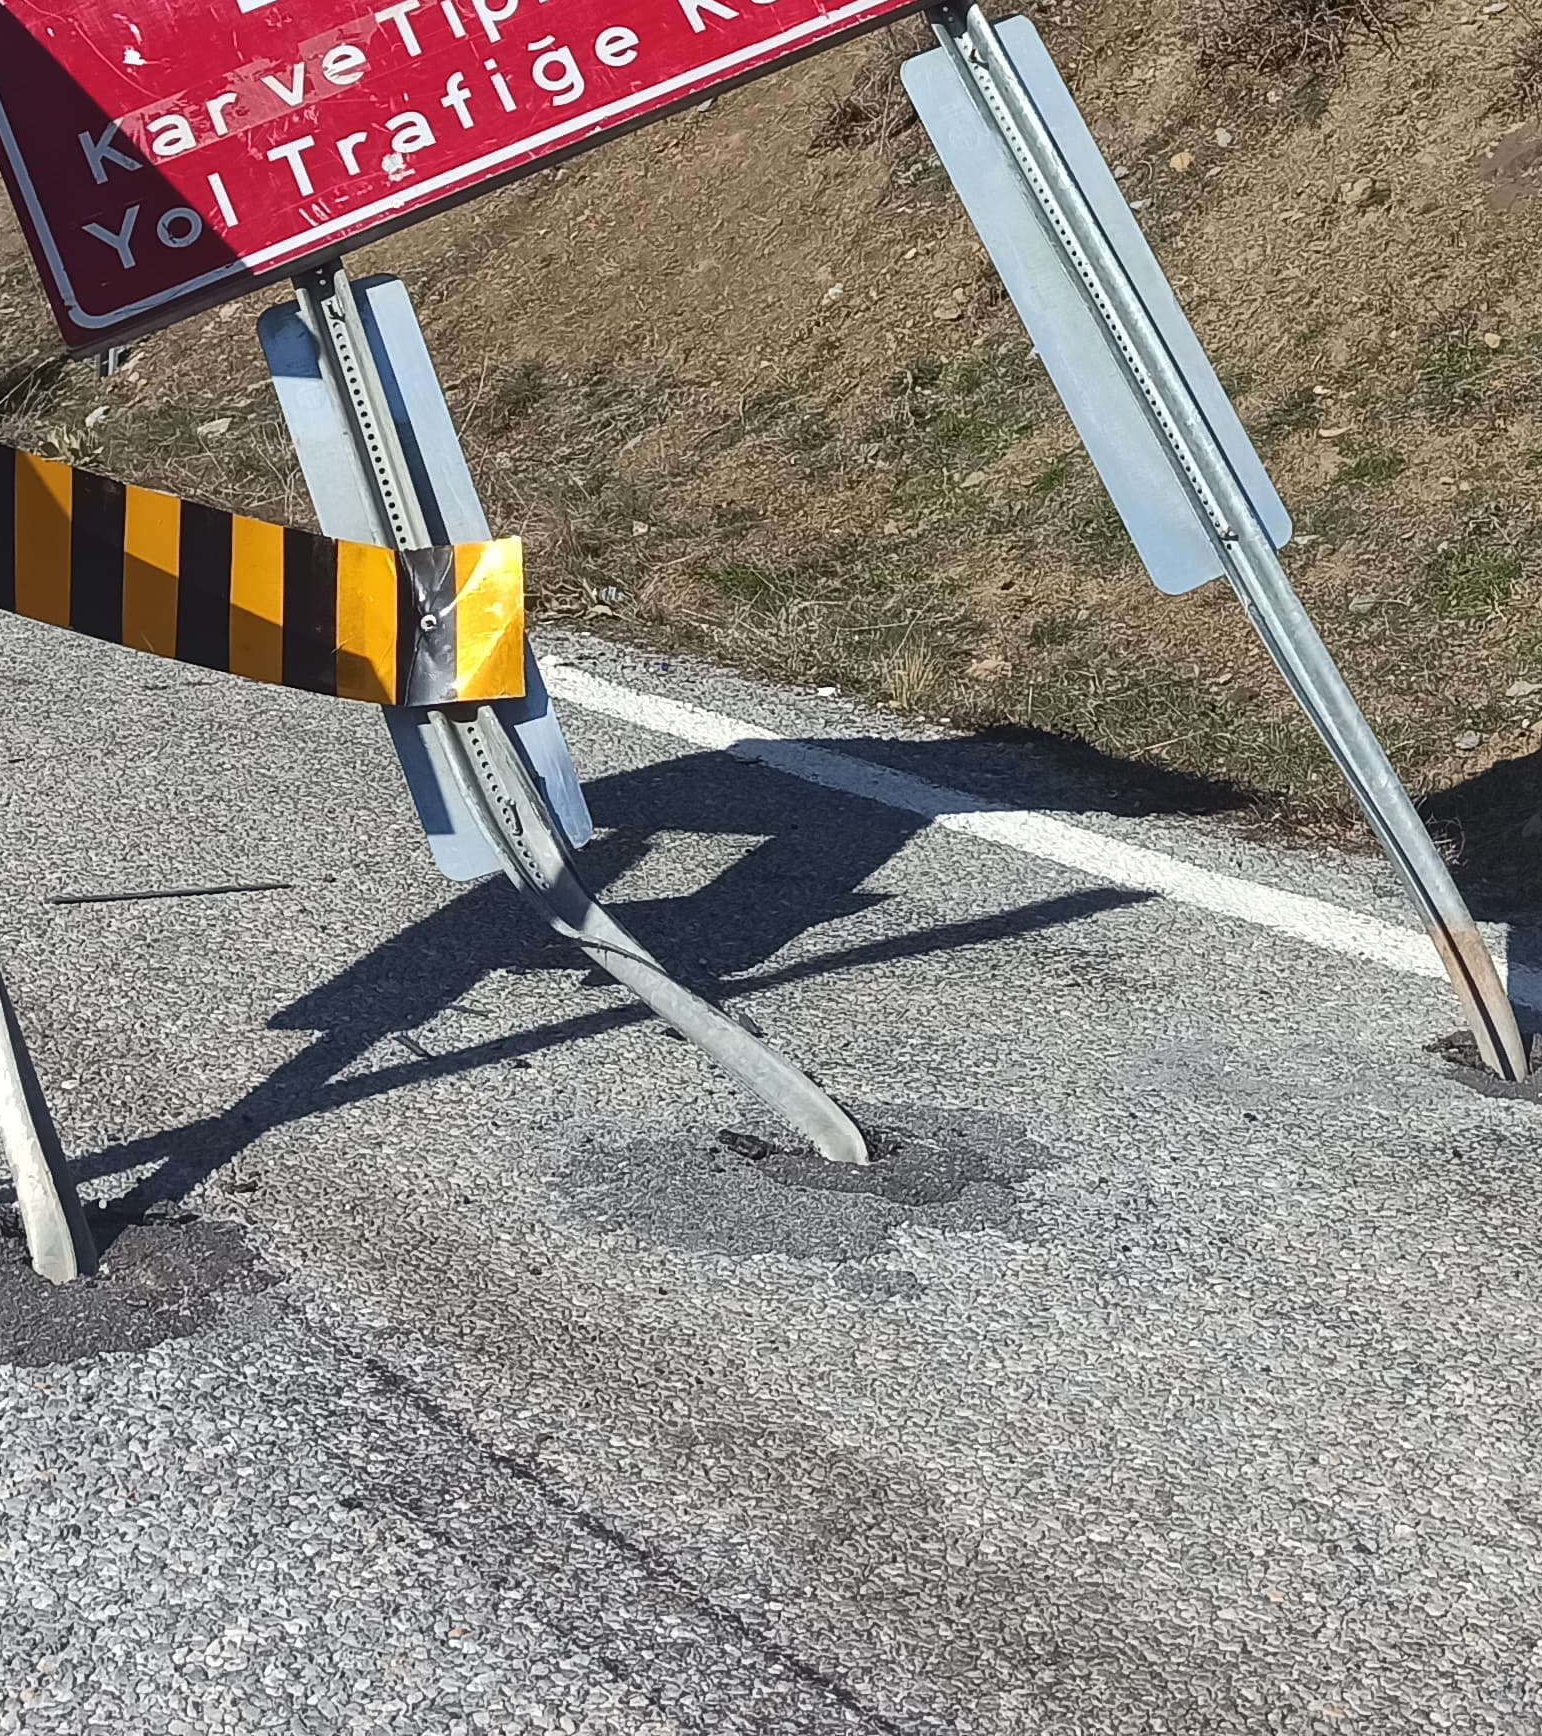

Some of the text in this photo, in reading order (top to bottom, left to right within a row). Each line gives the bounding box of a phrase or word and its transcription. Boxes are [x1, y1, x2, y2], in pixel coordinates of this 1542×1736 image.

[77, 91, 239, 185] Kar
[260, 43, 369, 107] ve
[81, 171, 240, 270] Yol
[266, 24, 641, 198] Trafiğe
